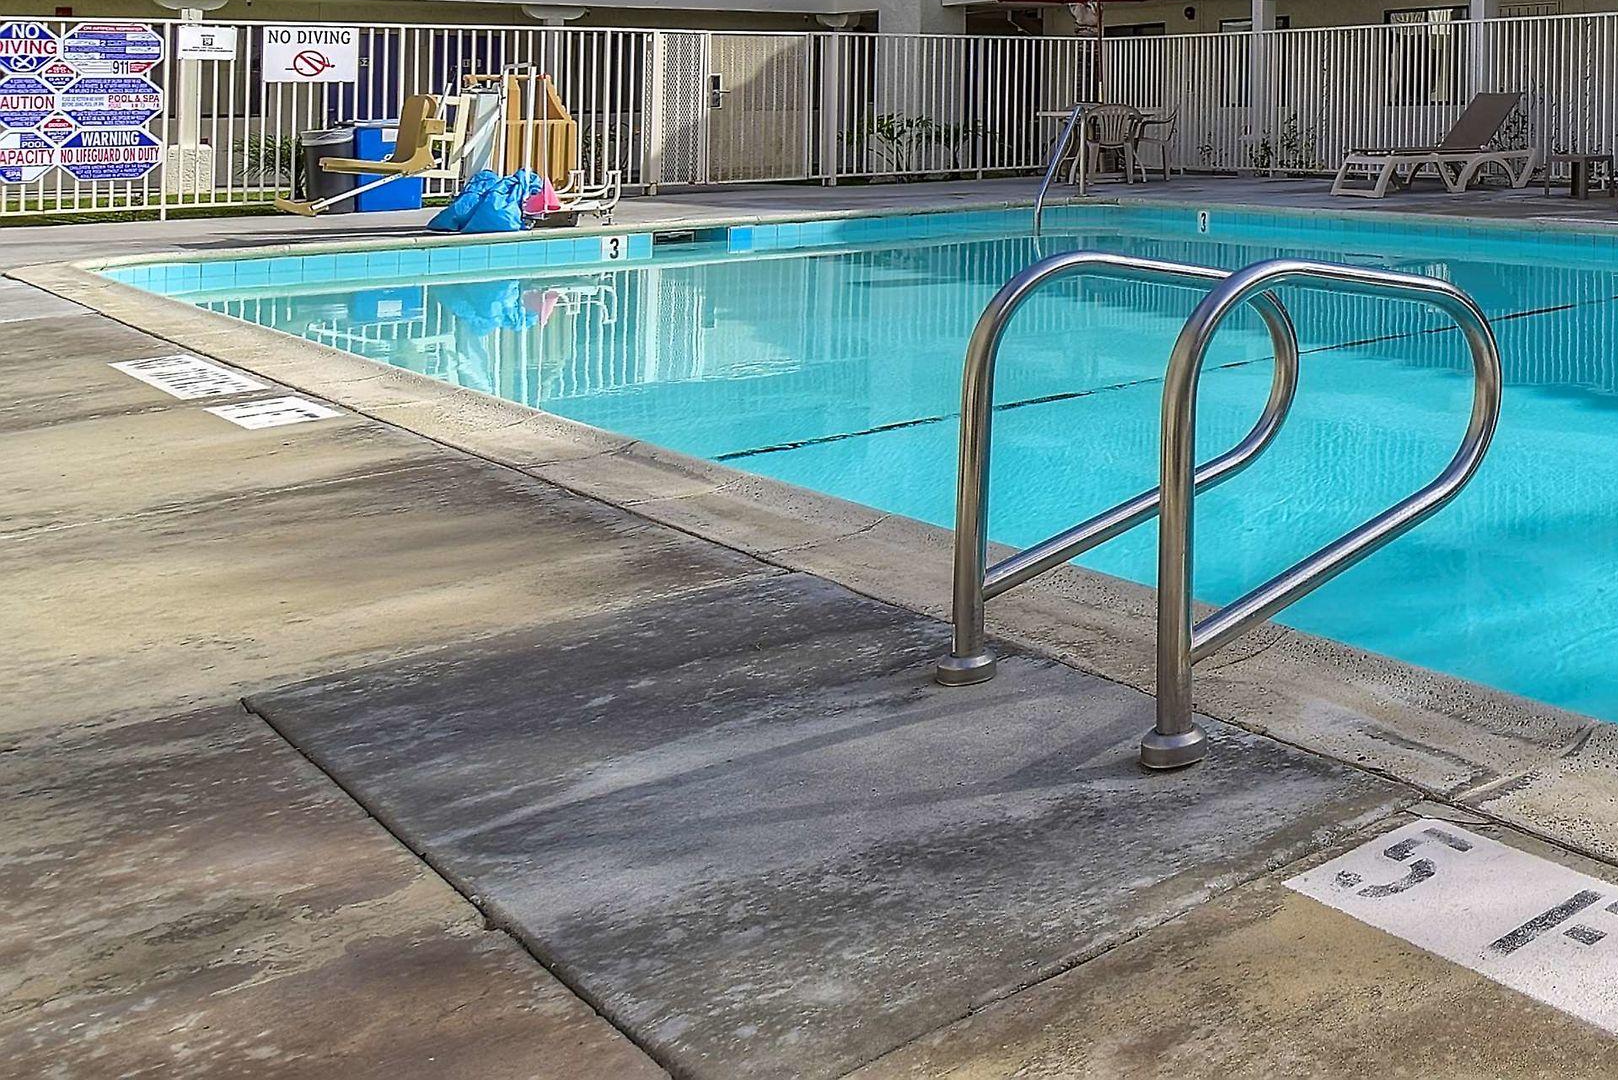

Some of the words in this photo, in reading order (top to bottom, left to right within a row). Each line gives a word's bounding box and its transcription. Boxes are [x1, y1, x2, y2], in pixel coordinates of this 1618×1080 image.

[11, 24, 40, 39] NO
[268, 30, 291, 44] NO
[297, 30, 351, 45] DIVING
[112, 61, 129, 75] 911
[0, 96, 55, 110] AUTION
[108, 94, 133, 103] POOL
[142, 94, 160, 103] SPA
[80, 131, 140, 147] WARNING
[0, 150, 55, 165] APACITY
[60, 149, 74, 163] NO
[76, 148, 121, 163] LIFEGUARD
[123, 148, 136, 162] ON
[138, 147, 160, 161] DUTY
[609, 238, 619, 259] 3
[1333, 826, 1474, 899] 5
